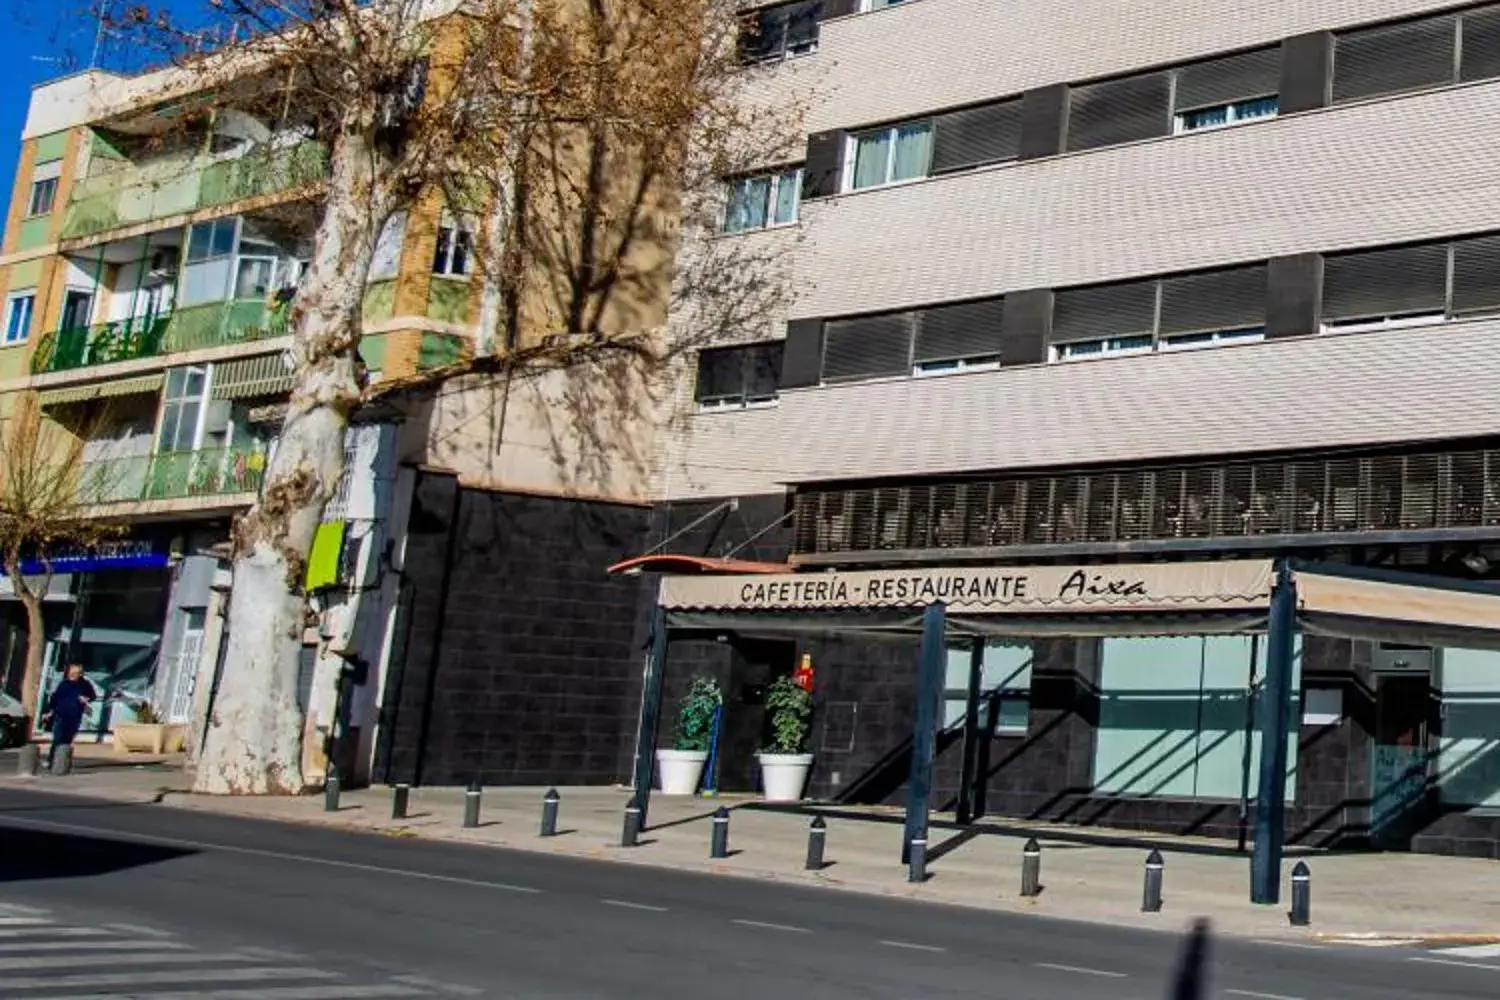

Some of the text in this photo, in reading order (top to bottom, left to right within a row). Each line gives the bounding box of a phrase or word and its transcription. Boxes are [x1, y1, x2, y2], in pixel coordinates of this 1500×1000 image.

[741, 576, 848, 602] CAFETERÍA
[867, 576, 1029, 599] RESTAURANTE
[1058, 569, 1148, 597] Aixa
